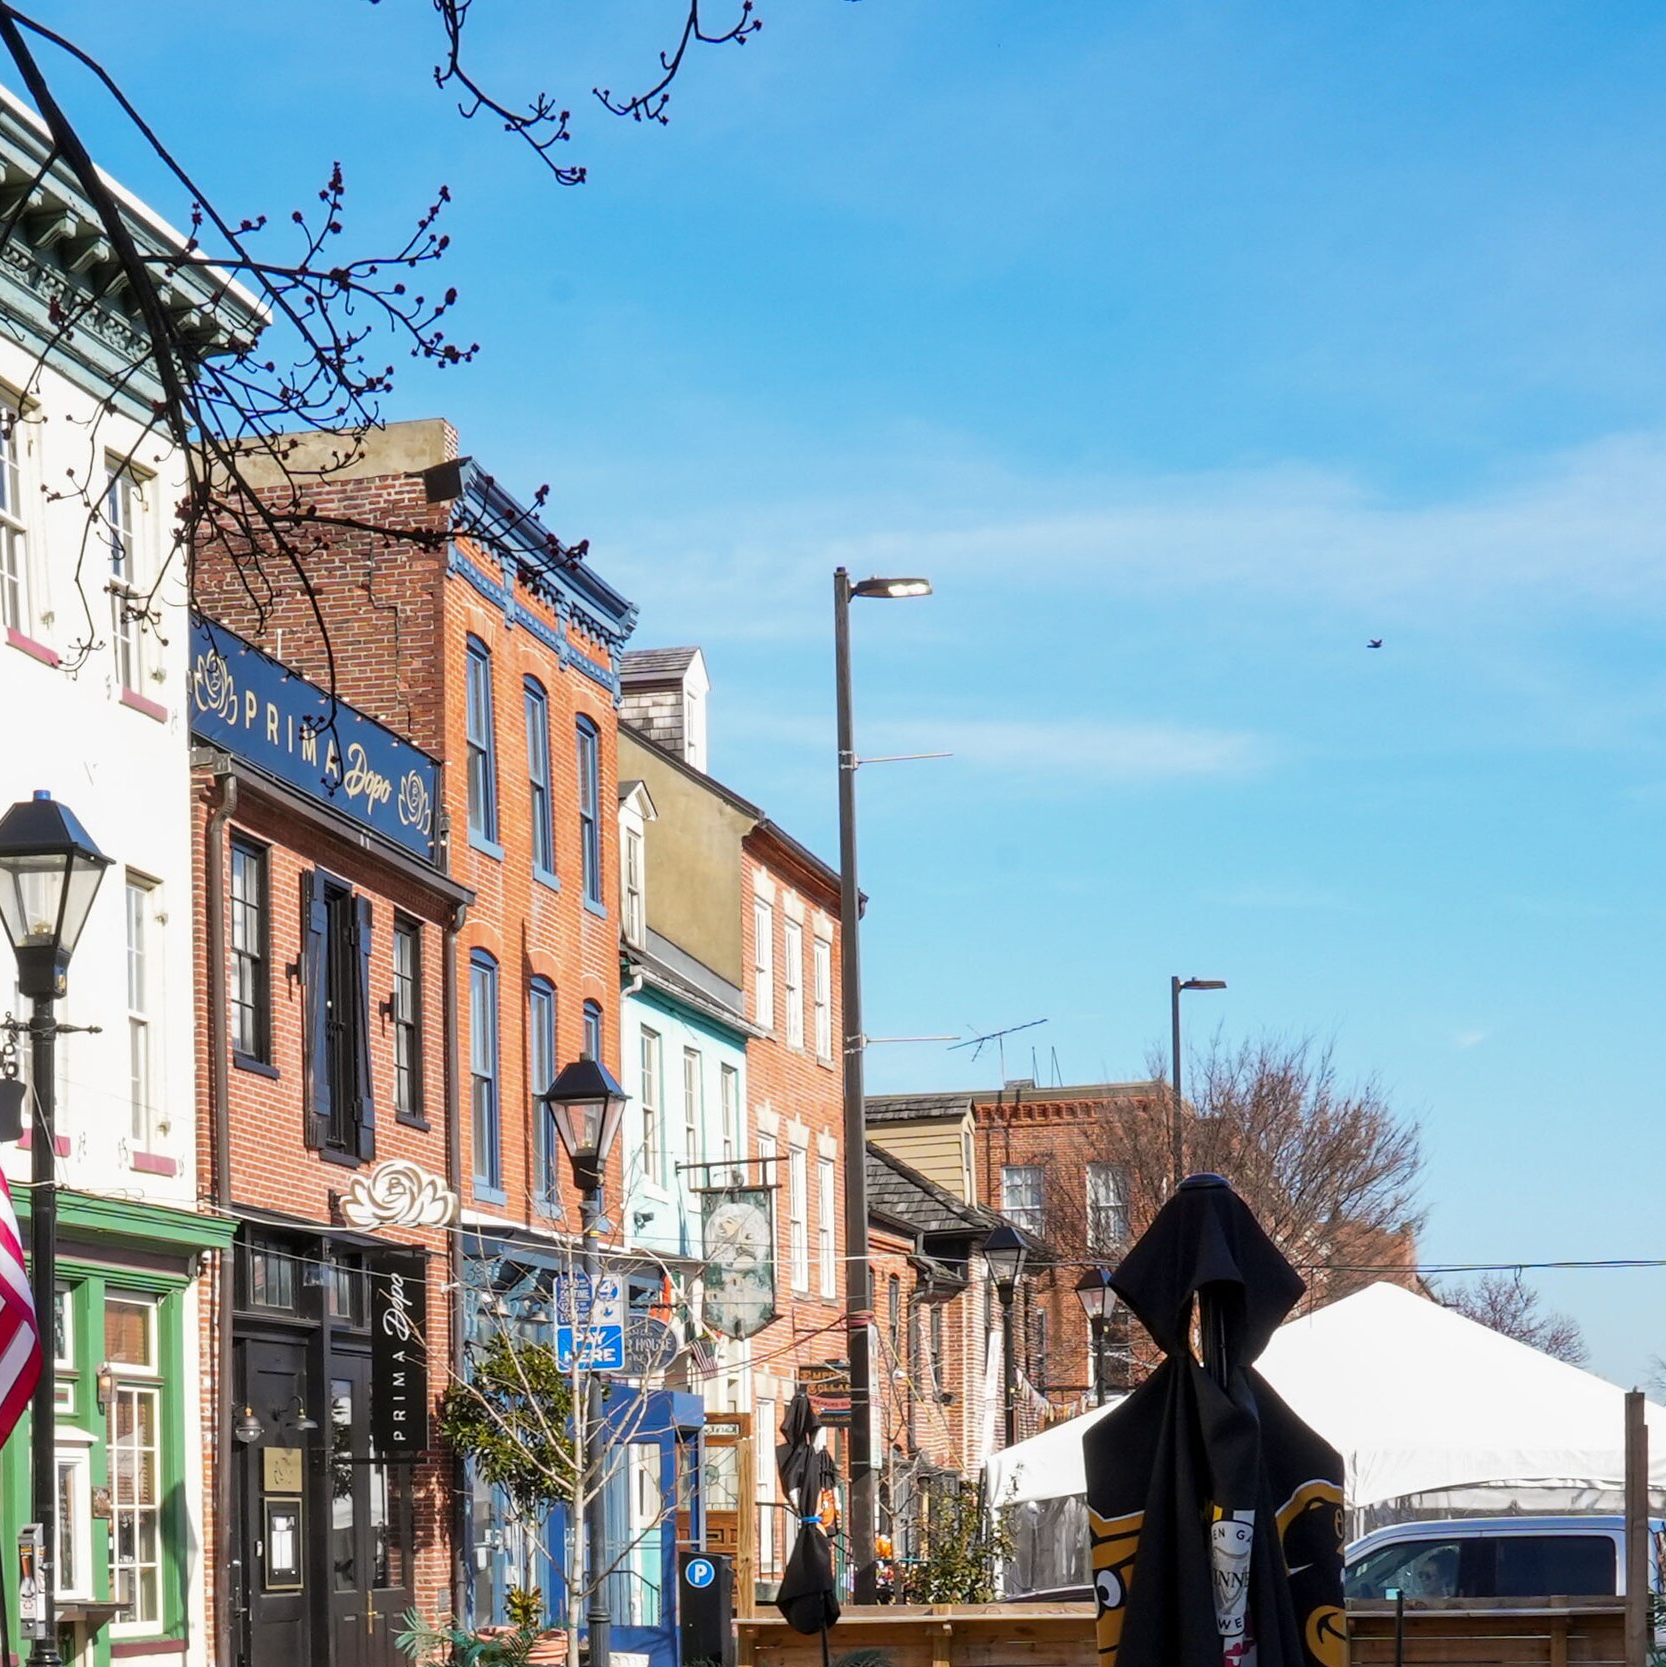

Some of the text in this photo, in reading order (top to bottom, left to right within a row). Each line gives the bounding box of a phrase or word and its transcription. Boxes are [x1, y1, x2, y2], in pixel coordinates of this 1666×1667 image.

[245, 690, 338, 778] PRIMA
[343, 743, 392, 815] Dopo
[383, 1272, 413, 1441] PRIMA Dopo
[564, 1348, 616, 1362] HERE
[574, 1331, 606, 1345] PAY
